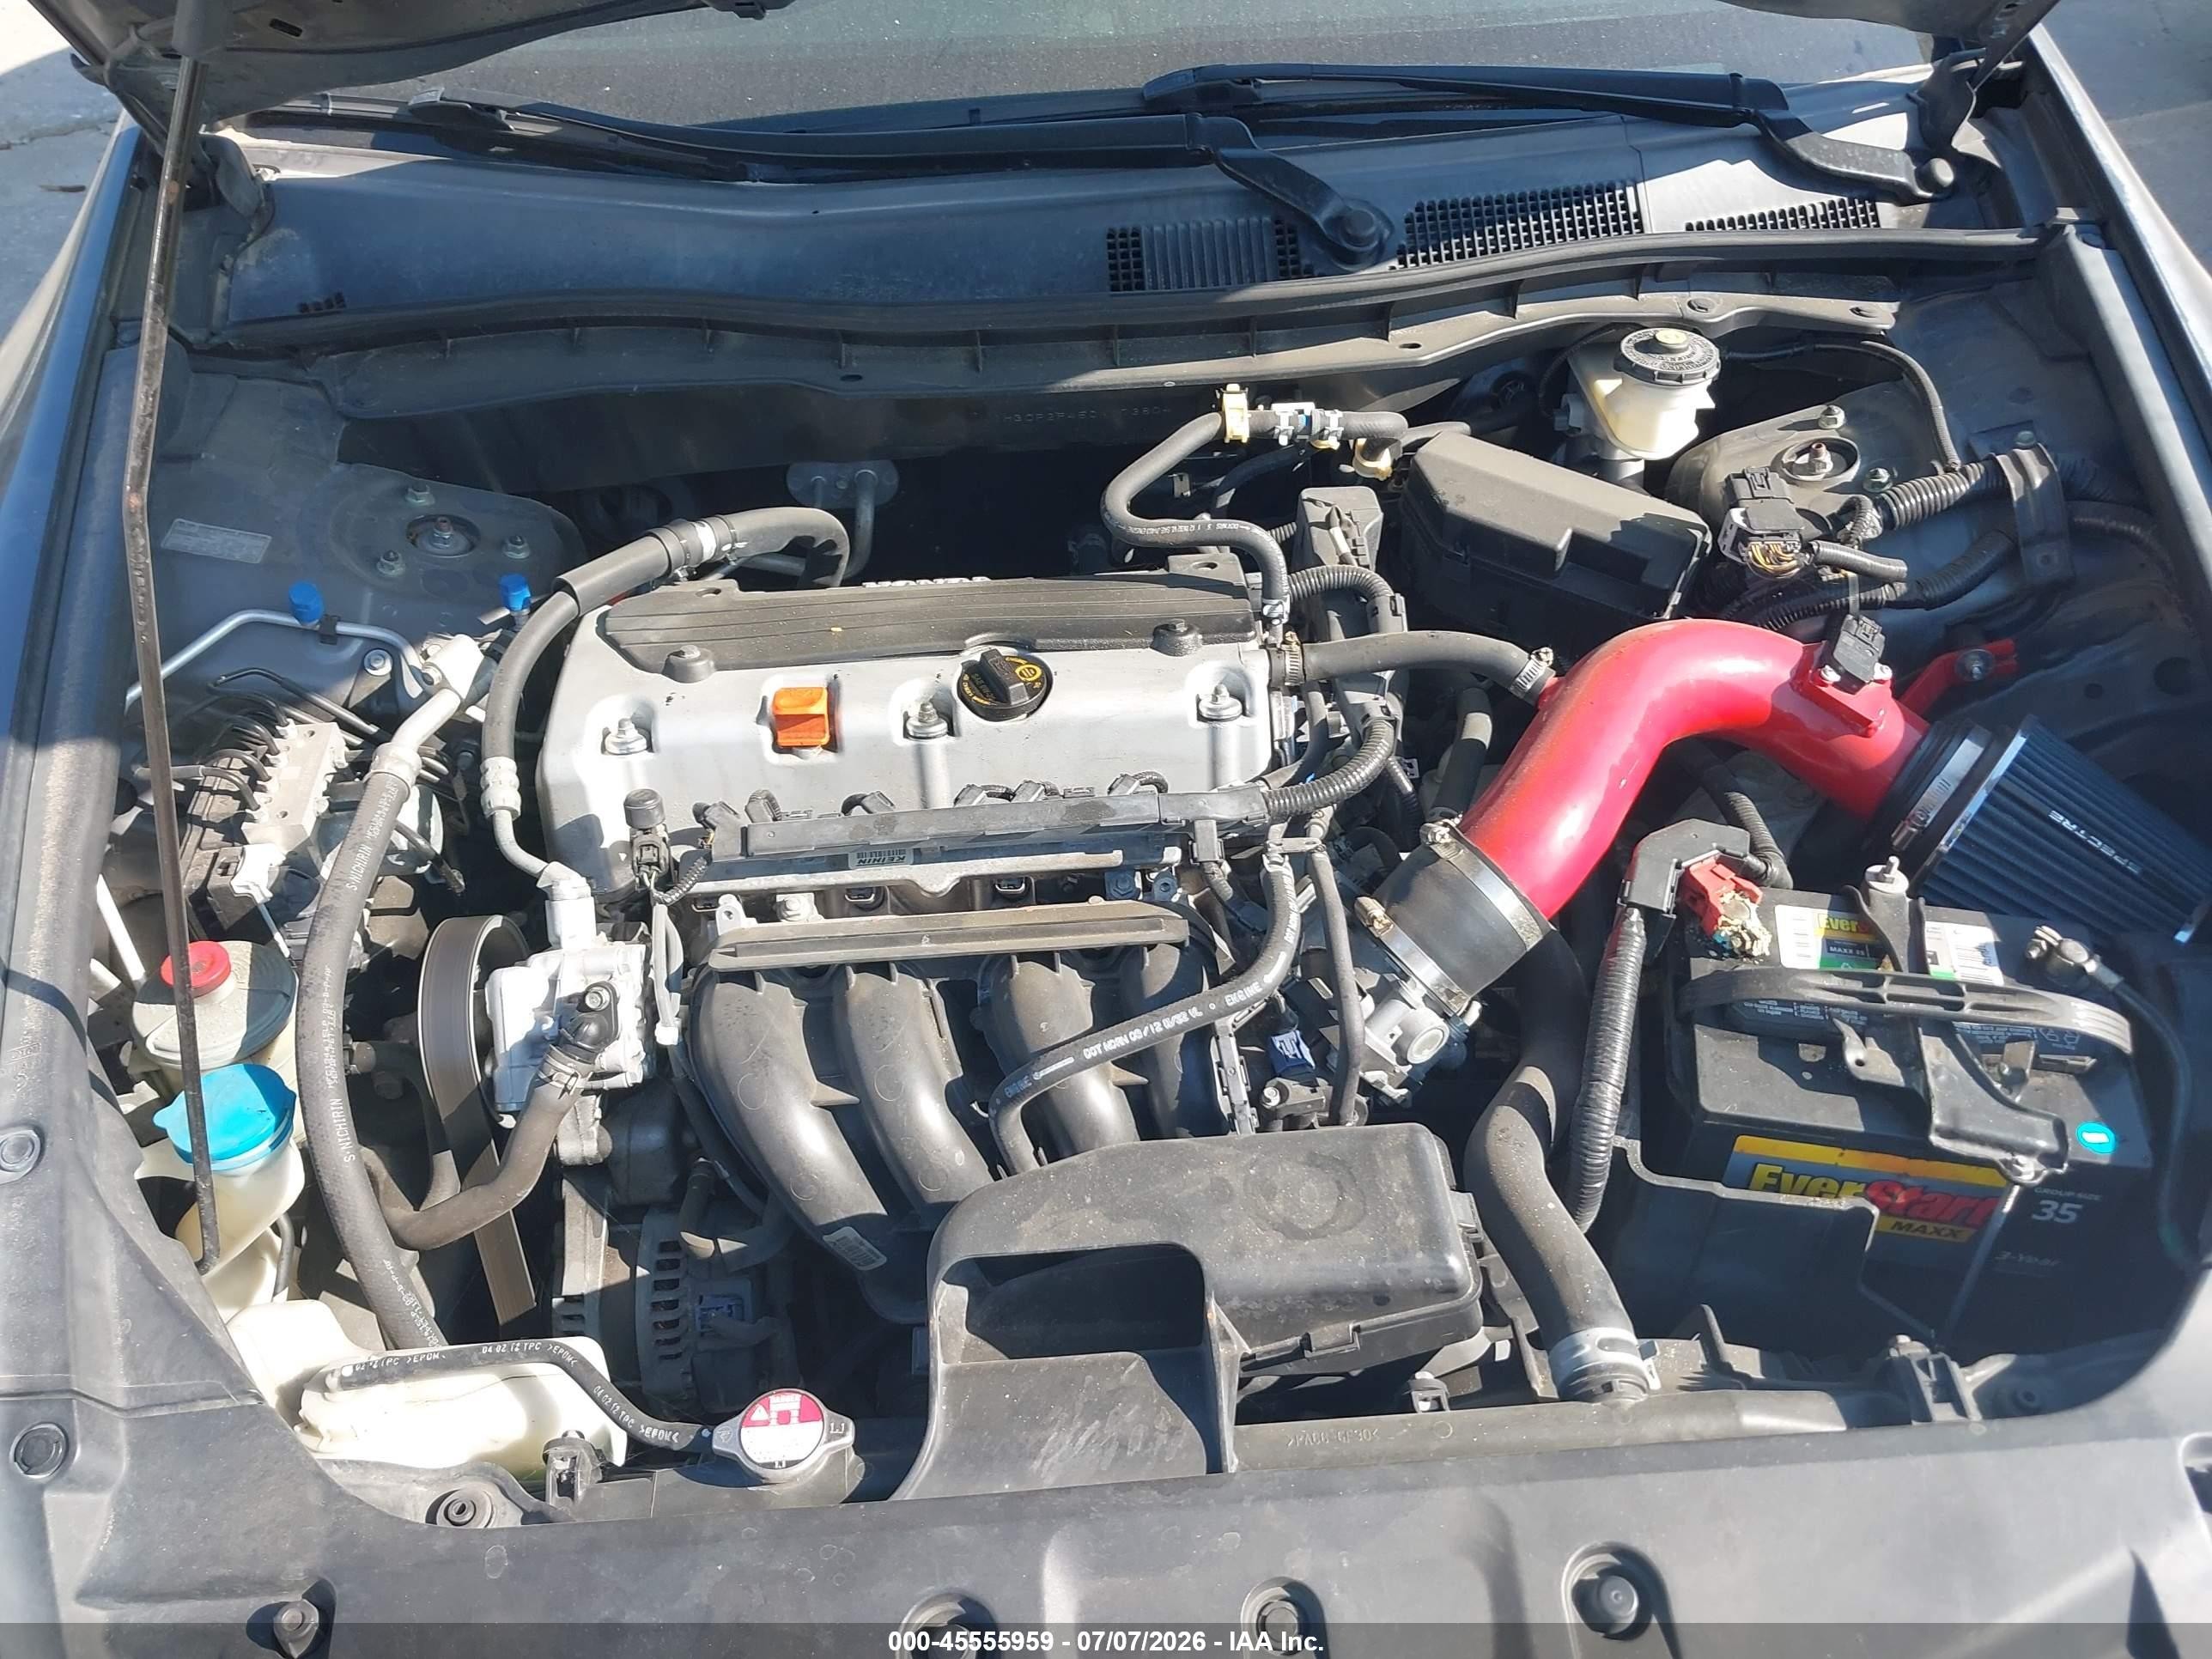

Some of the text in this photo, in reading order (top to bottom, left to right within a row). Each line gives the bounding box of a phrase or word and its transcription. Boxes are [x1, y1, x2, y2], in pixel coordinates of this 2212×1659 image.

[2048, 810, 2142, 874] SPECTRE
[857, 855, 906, 866] KEIHIN
[2032, 1199, 2083, 1224] 35
[1891, 1220, 1965, 1241] MAXX
[495, 1343, 507, 1353] 02
[523, 1342, 543, 1352] TPC
